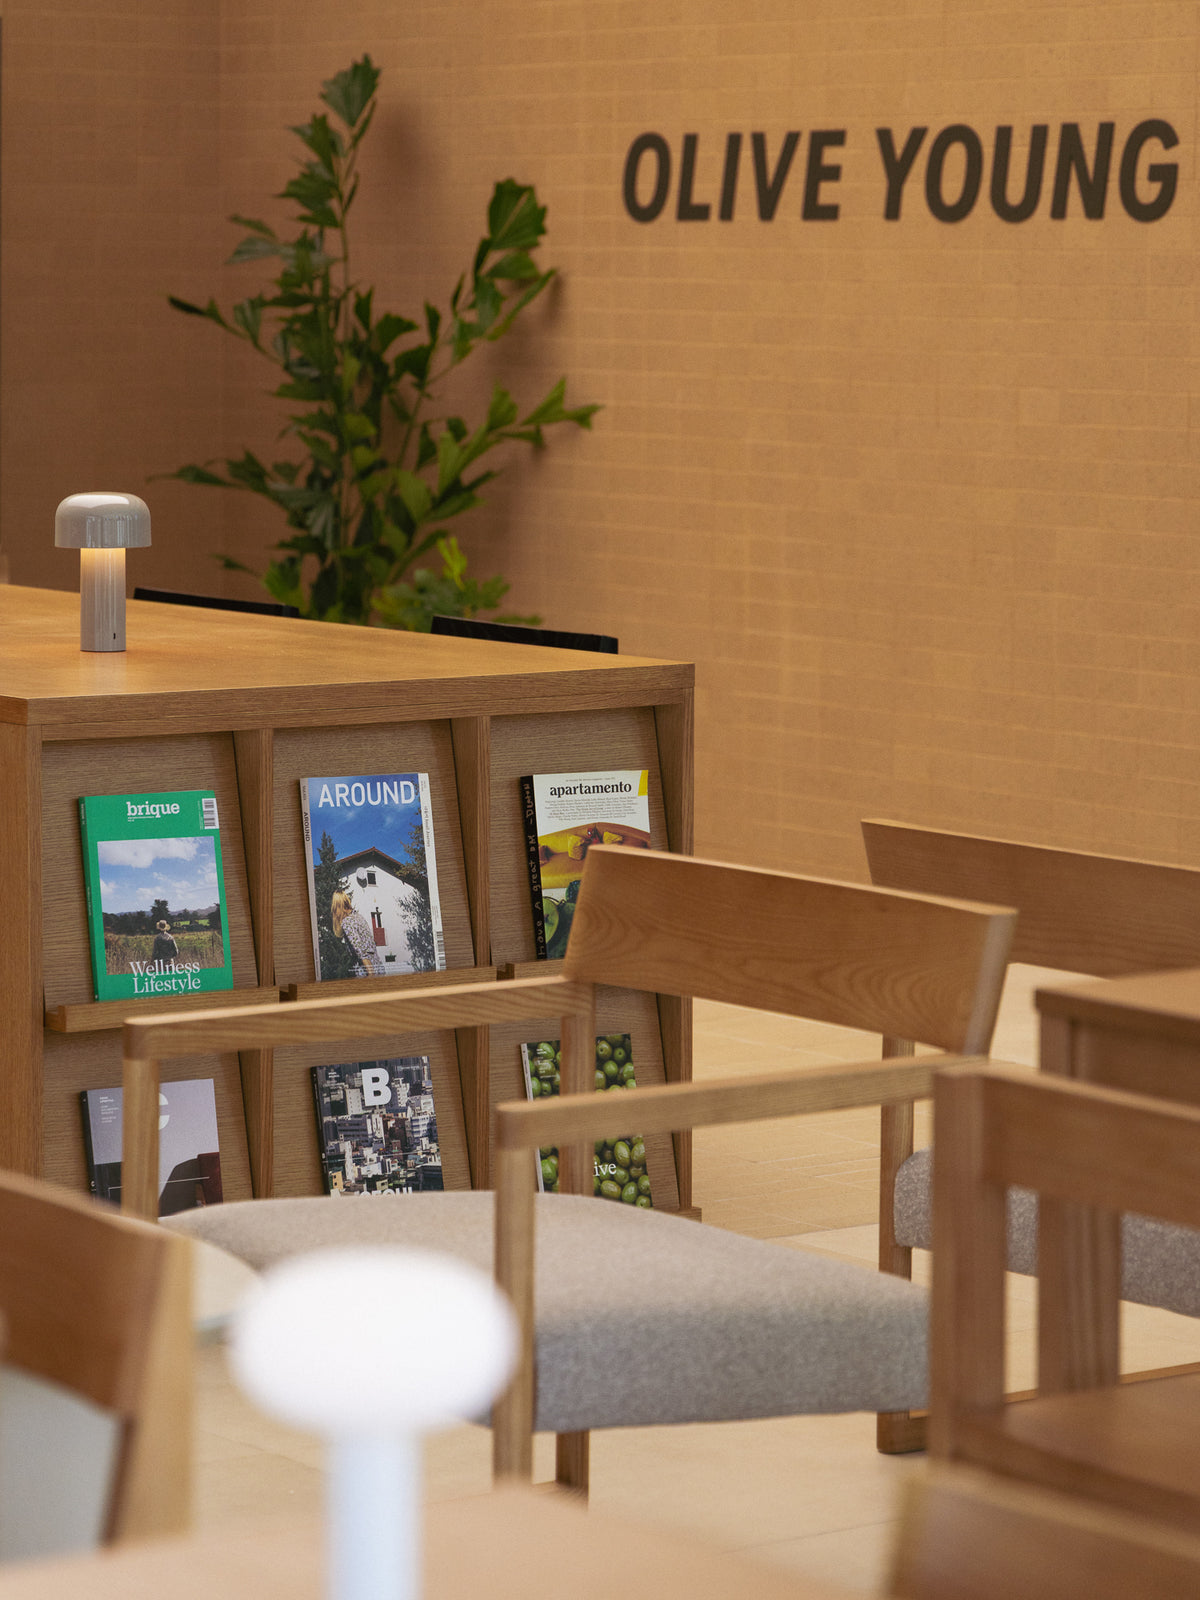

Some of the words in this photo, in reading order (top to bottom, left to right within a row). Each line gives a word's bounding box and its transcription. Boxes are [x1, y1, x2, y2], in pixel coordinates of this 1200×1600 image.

[623, 130, 848, 224] OLIVE
[875, 119, 1181, 224] YOUNG
[318, 780, 416, 808] AROUND
[549, 781, 632, 798] apartamento
[126, 801, 181, 818] brique
[303, 811, 311, 842] AROUND
[529, 860, 541, 892] great
[129, 958, 201, 977] Wellness
[132, 973, 201, 994] Lifestyle
[361, 1067, 392, 1107] B
[593, 1161, 617, 1177] ive
